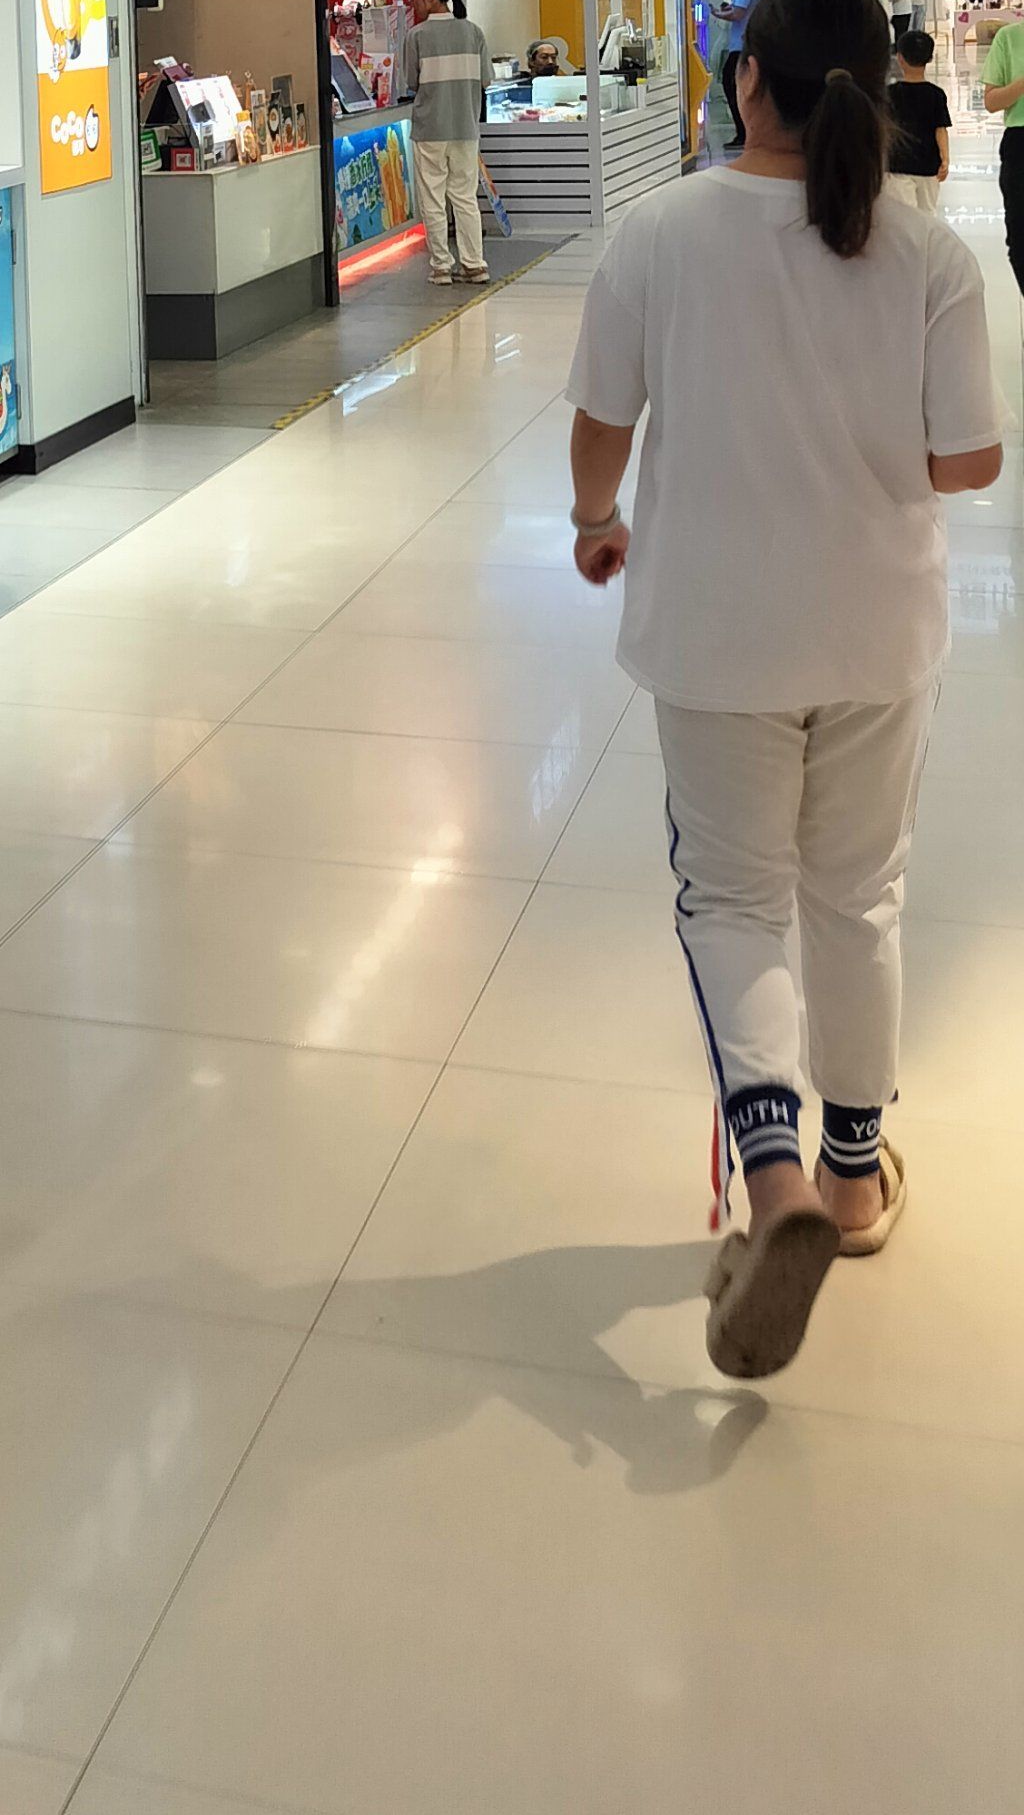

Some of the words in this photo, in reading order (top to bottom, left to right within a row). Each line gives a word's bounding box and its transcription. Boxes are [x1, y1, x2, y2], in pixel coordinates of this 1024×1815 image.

[51, 111, 84, 144] CoCo
[727, 1098, 789, 1137] OUTH
[850, 1115, 880, 1140] YO
